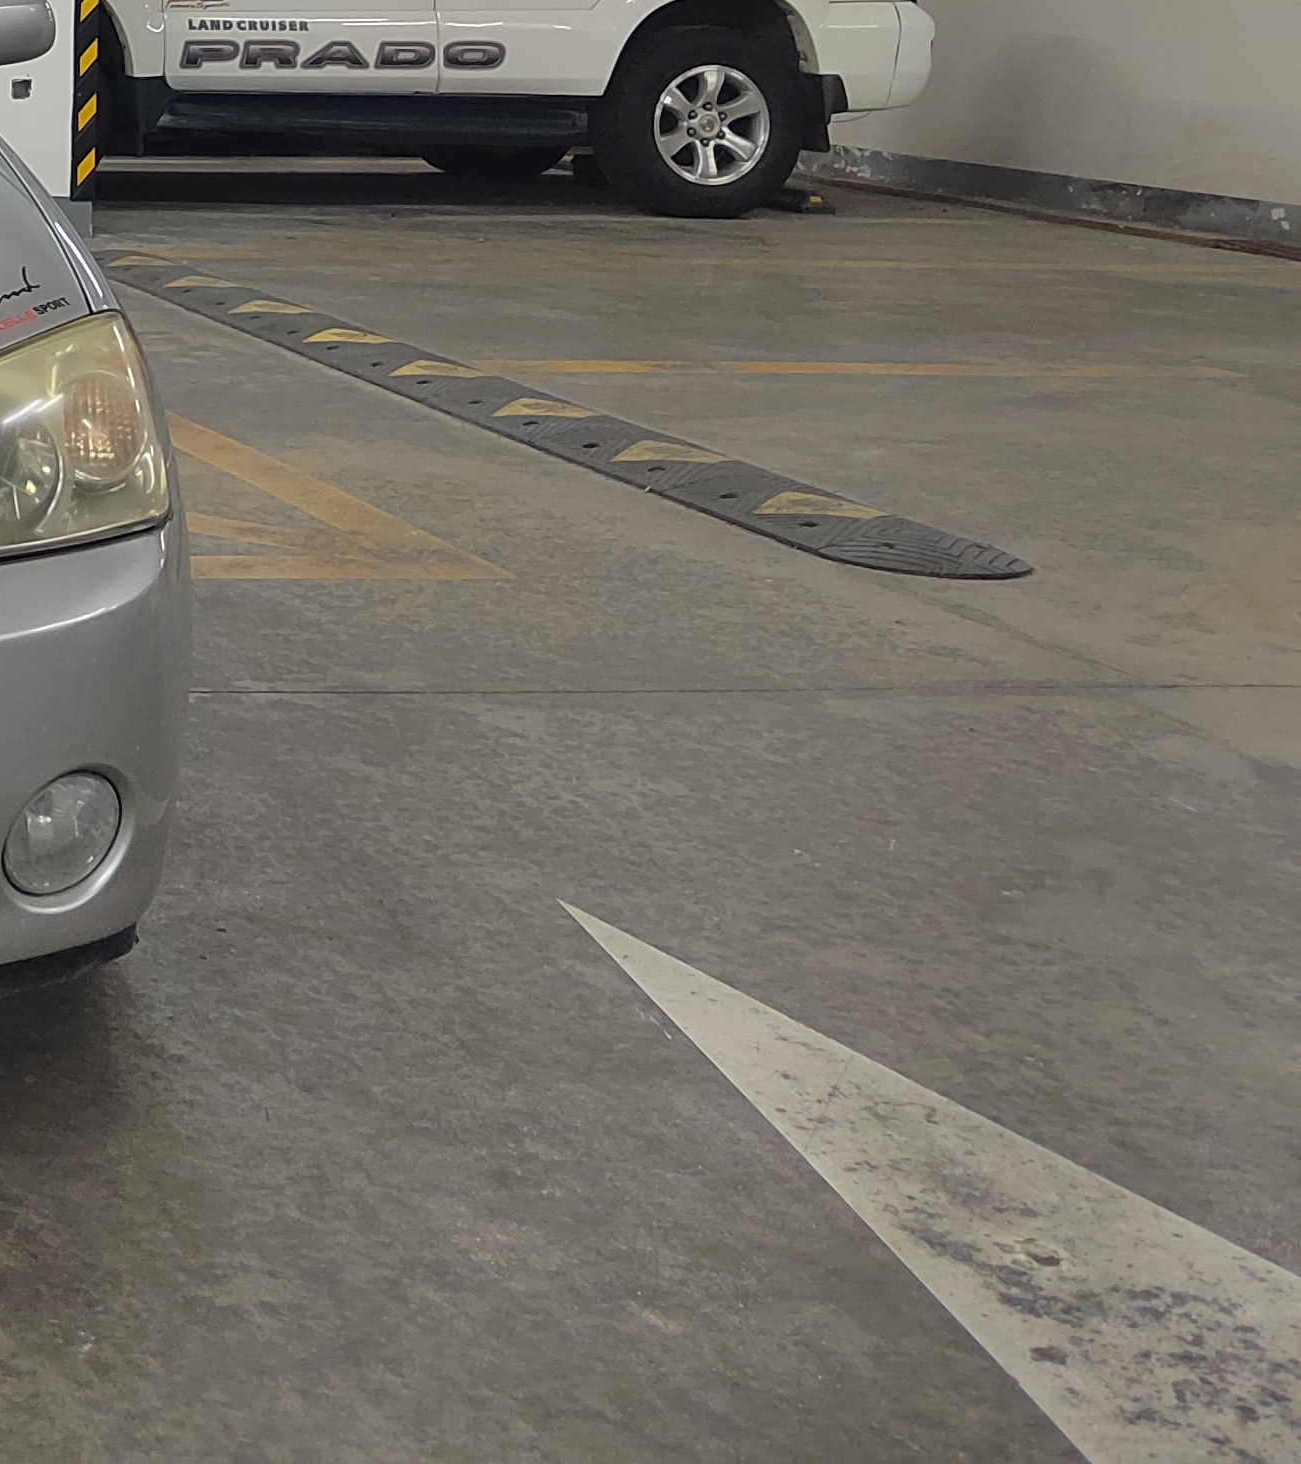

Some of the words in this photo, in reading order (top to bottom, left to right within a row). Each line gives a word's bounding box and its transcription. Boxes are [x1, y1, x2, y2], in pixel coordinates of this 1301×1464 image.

[188, 18, 234, 31] LAND
[236, 20, 310, 32] CRUISER
[179, 38, 507, 70] PRADO
